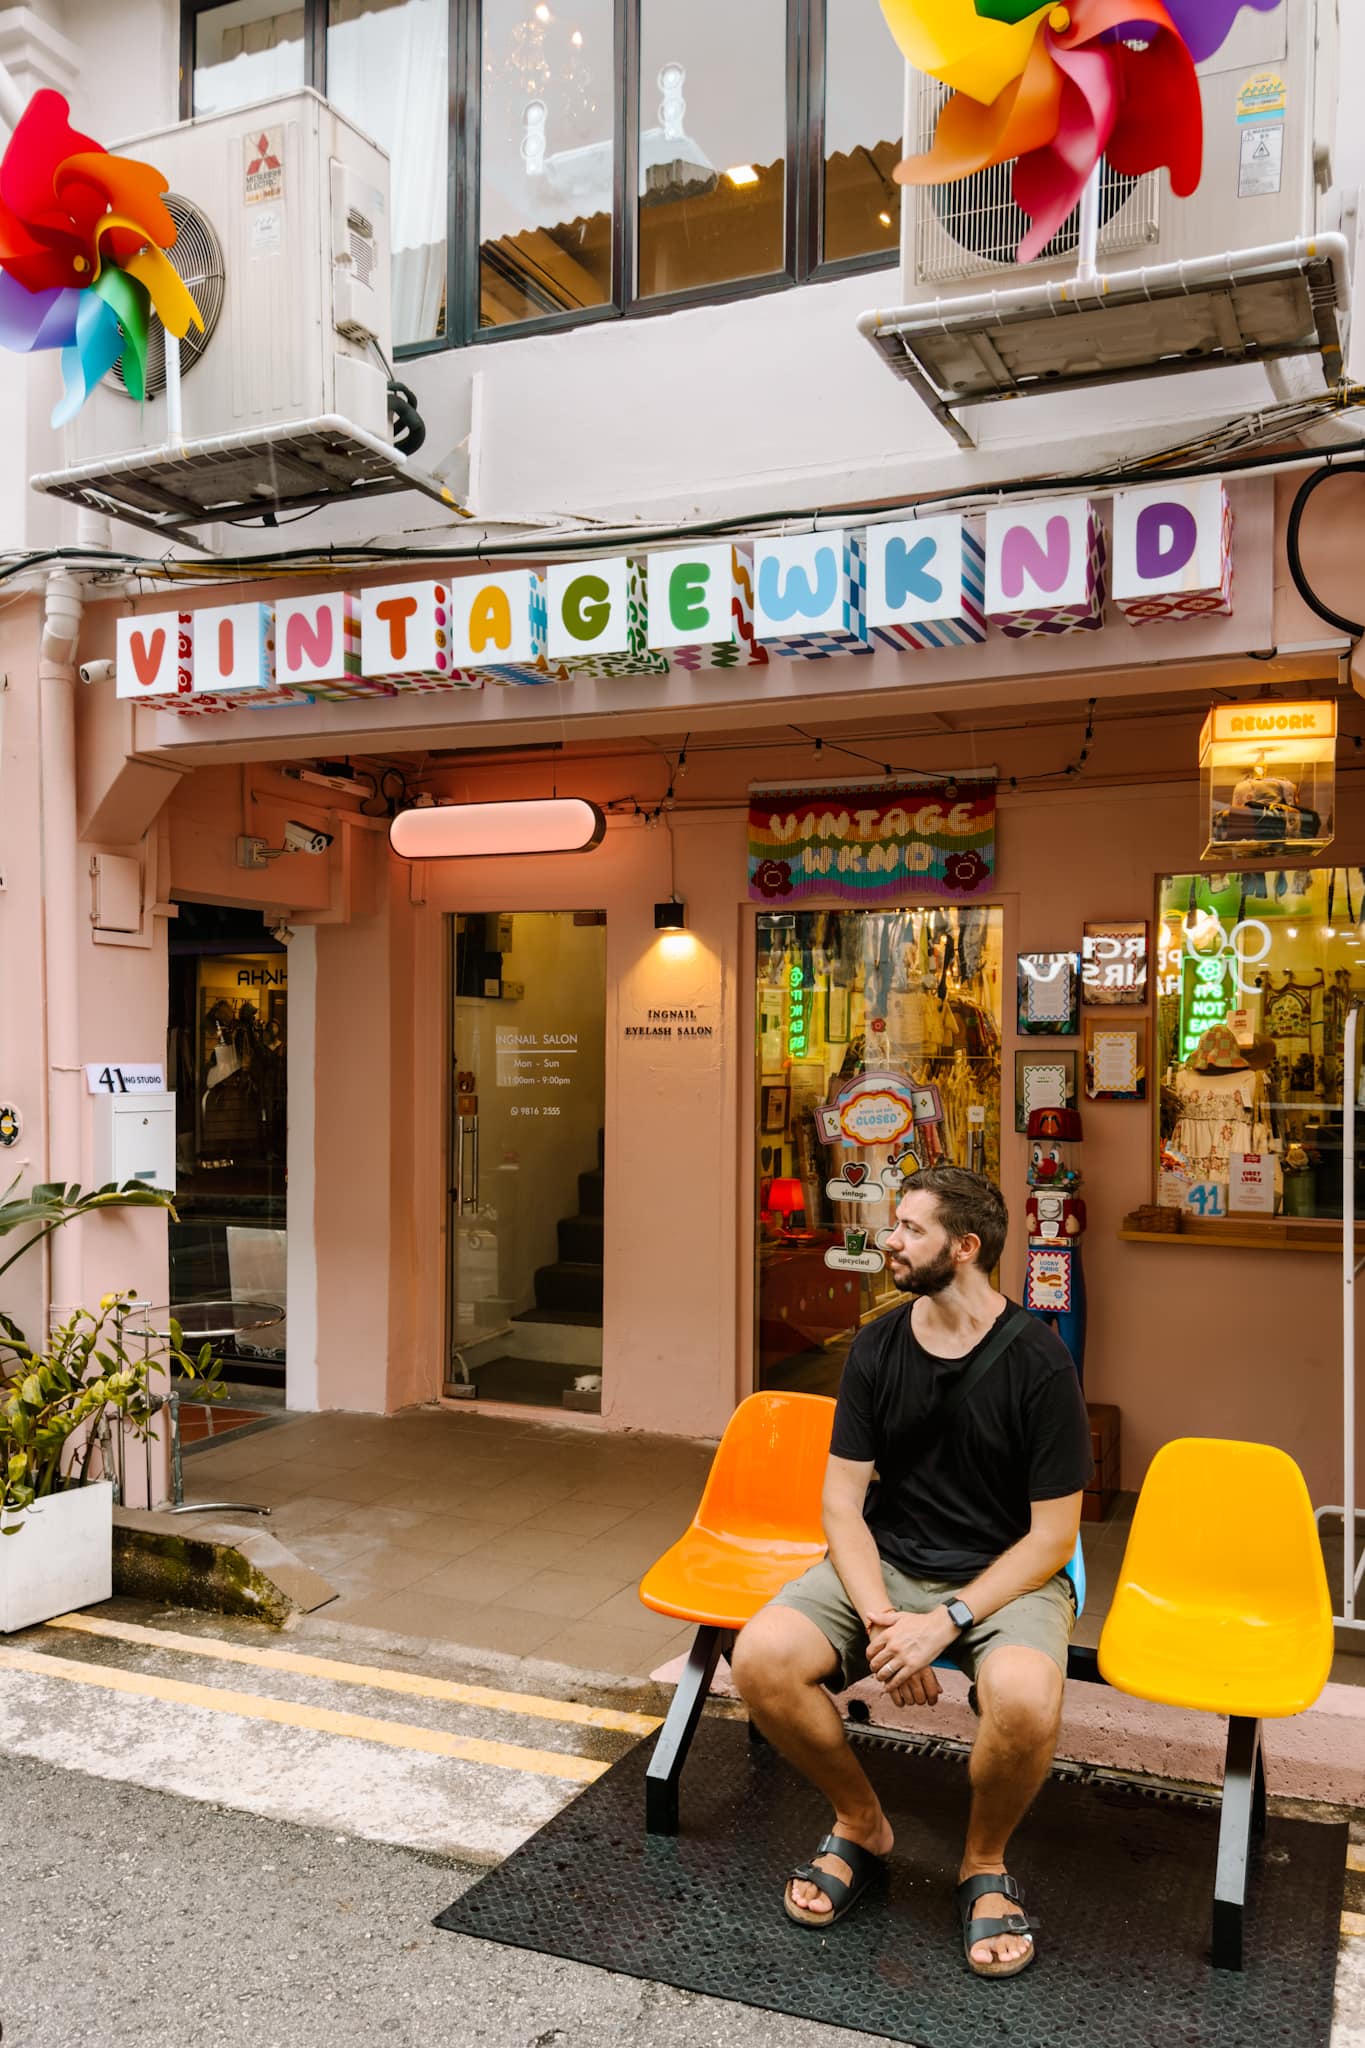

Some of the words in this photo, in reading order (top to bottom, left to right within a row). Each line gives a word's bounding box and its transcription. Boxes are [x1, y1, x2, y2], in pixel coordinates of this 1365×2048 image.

[1230, 714, 1316, 732] REWORK
[769, 803, 974, 841] VINTAGE
[802, 842, 933, 875] WKND
[1192, 1001, 1226, 1016] NOT
[648, 1010, 697, 1019] INGNAIL
[625, 1026, 672, 1036] EYELASH
[677, 1026, 713, 1036] SALON
[496, 1033, 538, 1045] INGNAIL
[543, 1033, 578, 1045] SALON
[513, 1059, 533, 1069] Mon
[544, 1058, 560, 1069] Sun
[98, 1066, 130, 1094] 41
[137, 1075, 162, 1084] STUDIO
[542, 1075, 571, 1086] 9:00pm
[520, 1106, 540, 1116] 9816
[855, 1113, 898, 1127] CLOSED
[841, 1188, 868, 1199] vintage
[1188, 1184, 1223, 1216] 41
[838, 1256, 871, 1266] upcycled
